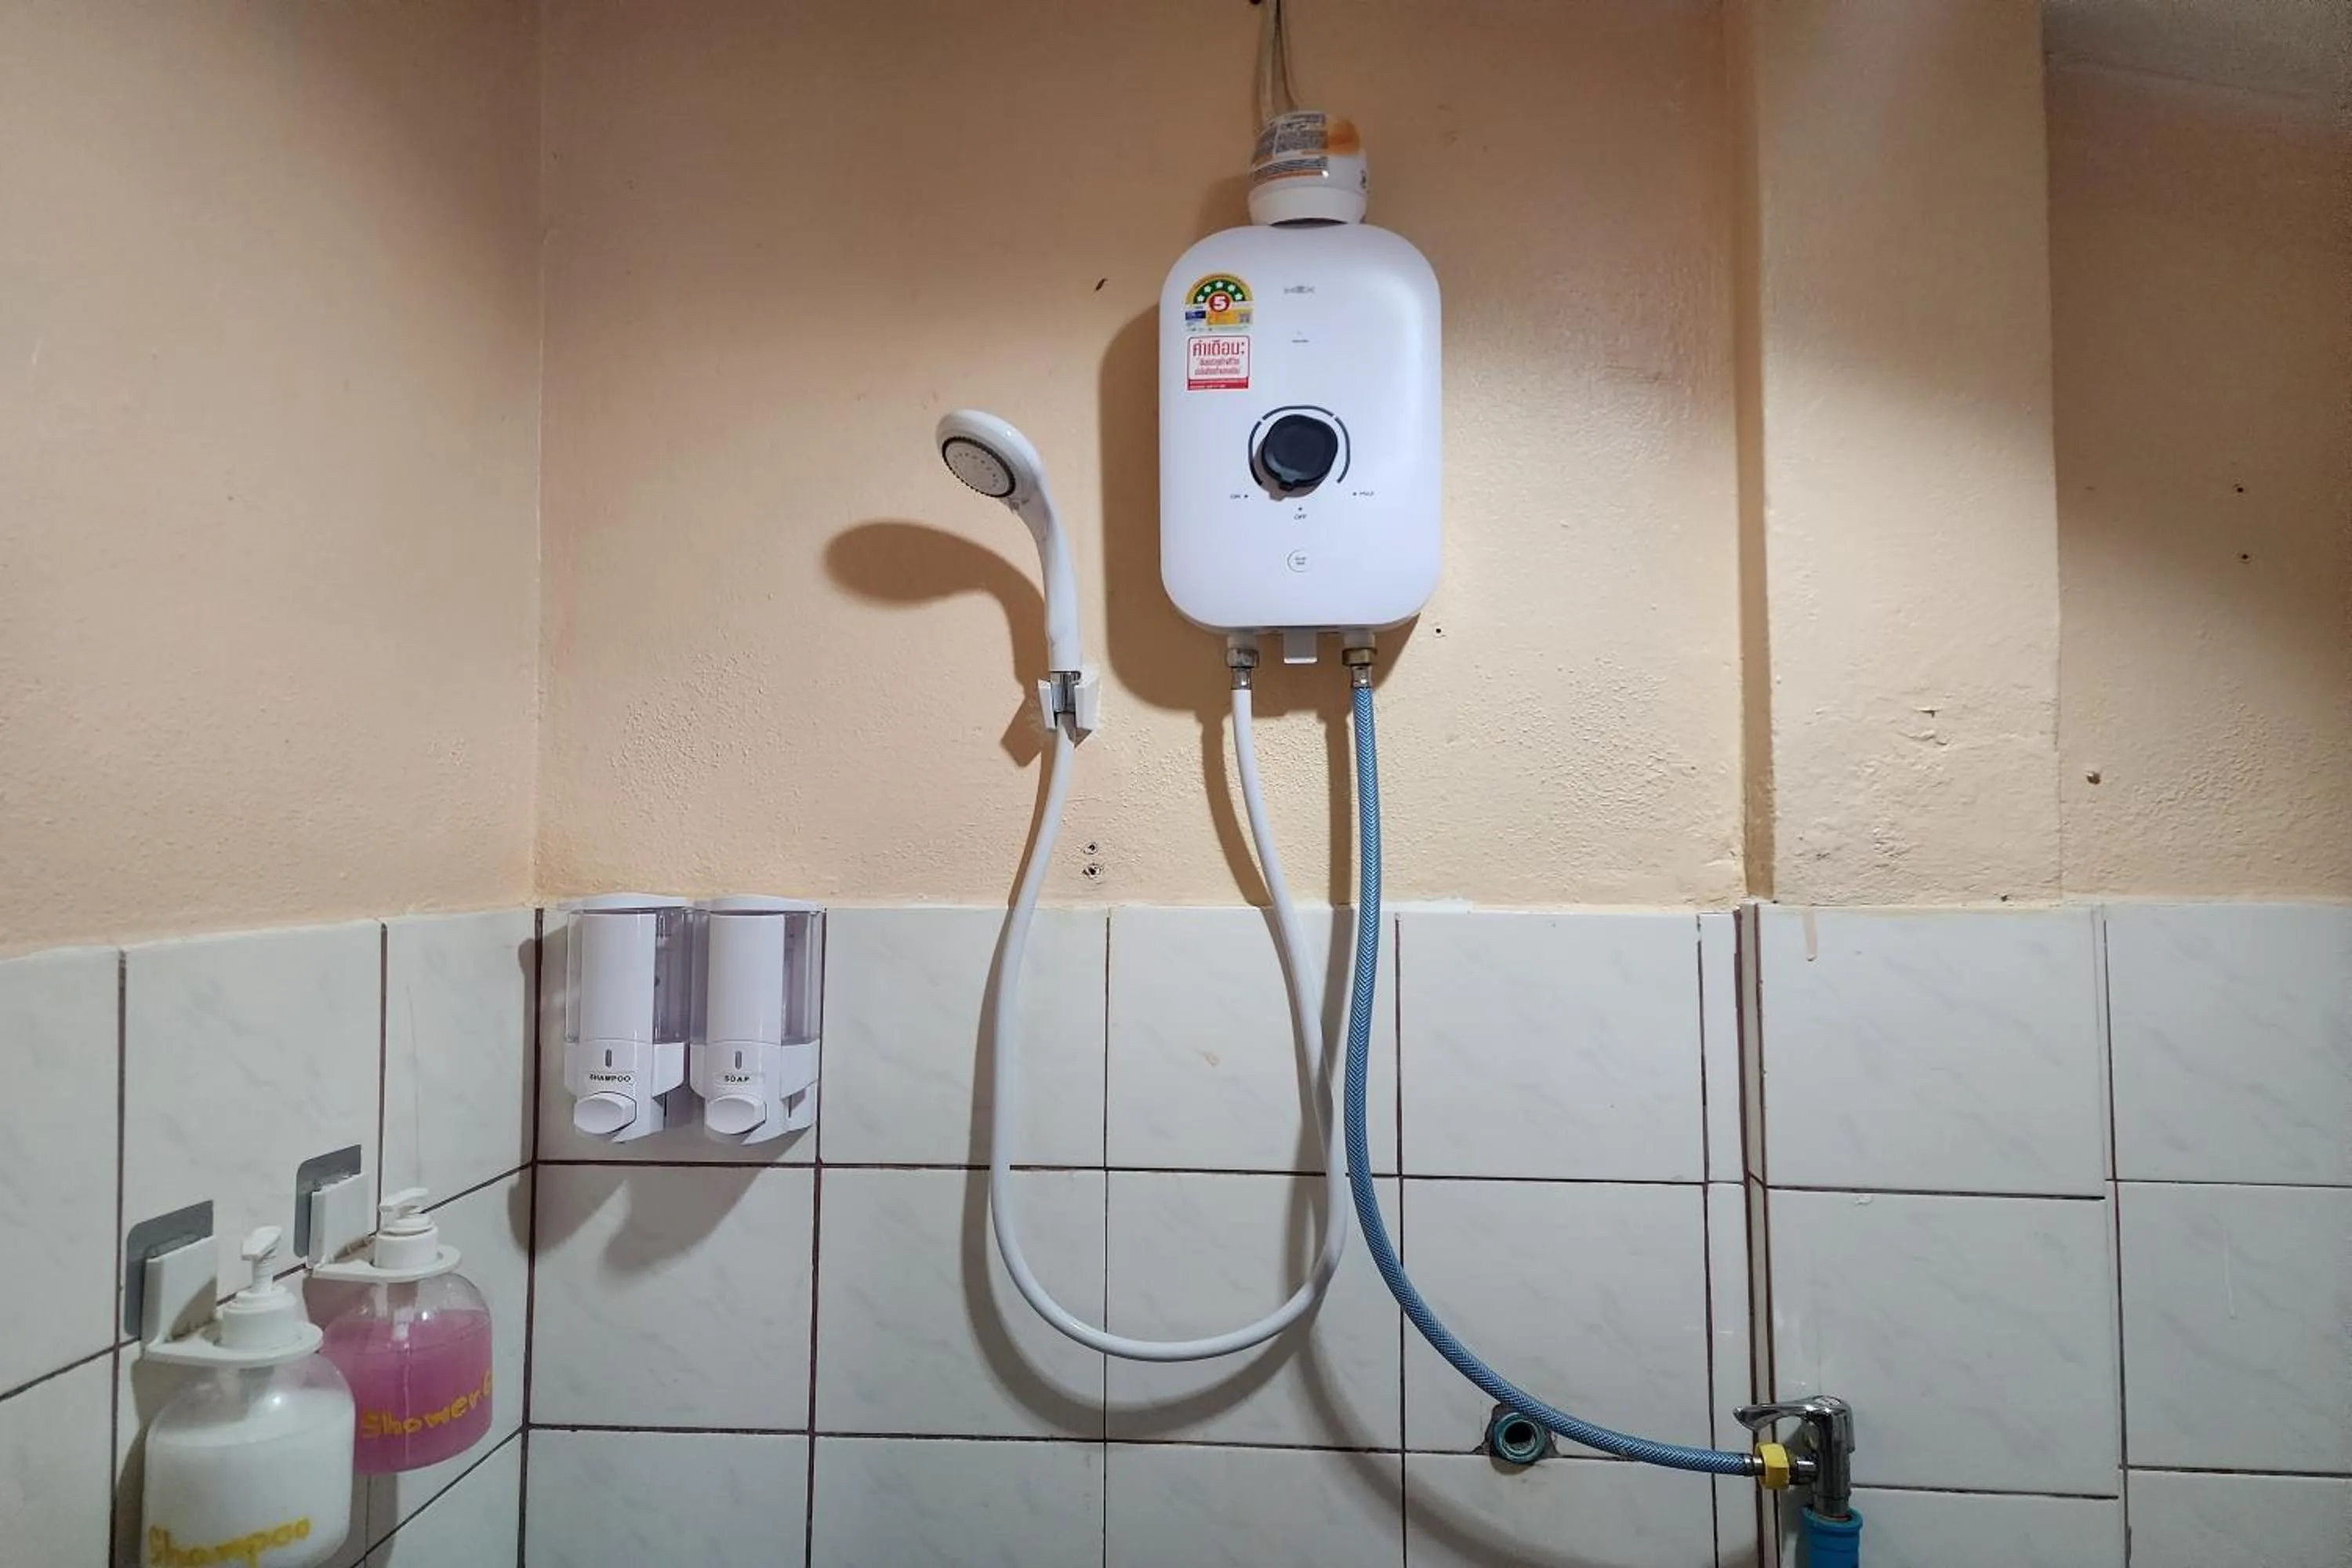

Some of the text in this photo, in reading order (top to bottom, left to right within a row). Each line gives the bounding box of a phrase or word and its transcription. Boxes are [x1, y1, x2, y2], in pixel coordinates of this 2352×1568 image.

[1213, 294, 1227, 310] 5
[589, 1073, 632, 1083] SHAMPOO
[724, 1074, 750, 1083] SOAP
[148, 1516, 311, 1568] Shampoo
